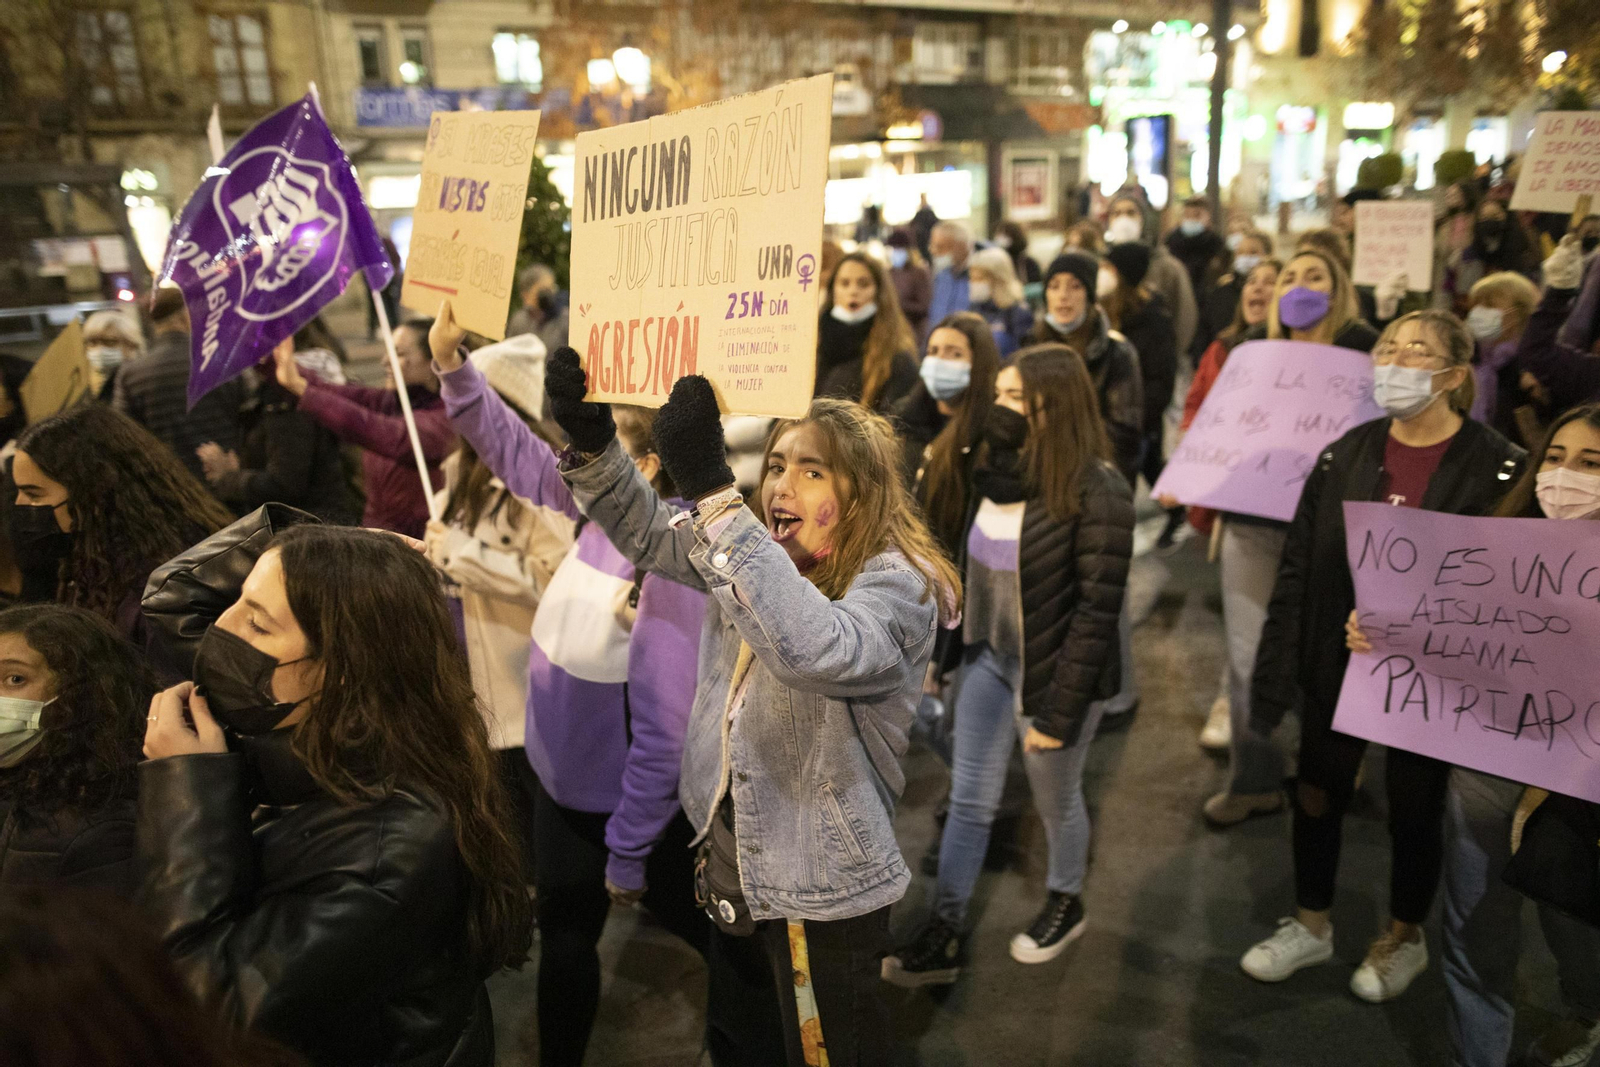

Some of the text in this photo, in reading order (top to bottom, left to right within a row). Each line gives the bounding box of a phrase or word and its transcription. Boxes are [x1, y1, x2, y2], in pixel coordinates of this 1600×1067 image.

[583, 89, 803, 223] NINGUNA RAZÓN
[609, 207, 738, 291] JUSTIFICA
[758, 244, 793, 281] UNA
[725, 291, 788, 320] 25N DÍA
[586, 300, 699, 395] AGRESIÓN
[718, 326, 775, 337] INTERNACIONAL
[727, 336, 778, 357] ELIMINACIÓN
[783, 344, 790, 353] DE
[728, 364, 759, 374] VIOLENCIA
[763, 365, 788, 374] CONTRA
[736, 378, 763, 391] MUJER
[1274, 368, 1306, 390] LA
[1293, 414, 1351, 434] HAN
[1357, 527, 1418, 573] NO
[1434, 548, 1496, 587] ES
[1512, 550, 1577, 598] UN
[1411, 592, 1572, 635] AISLADO
[1358, 612, 1540, 676] SE LLAMA
